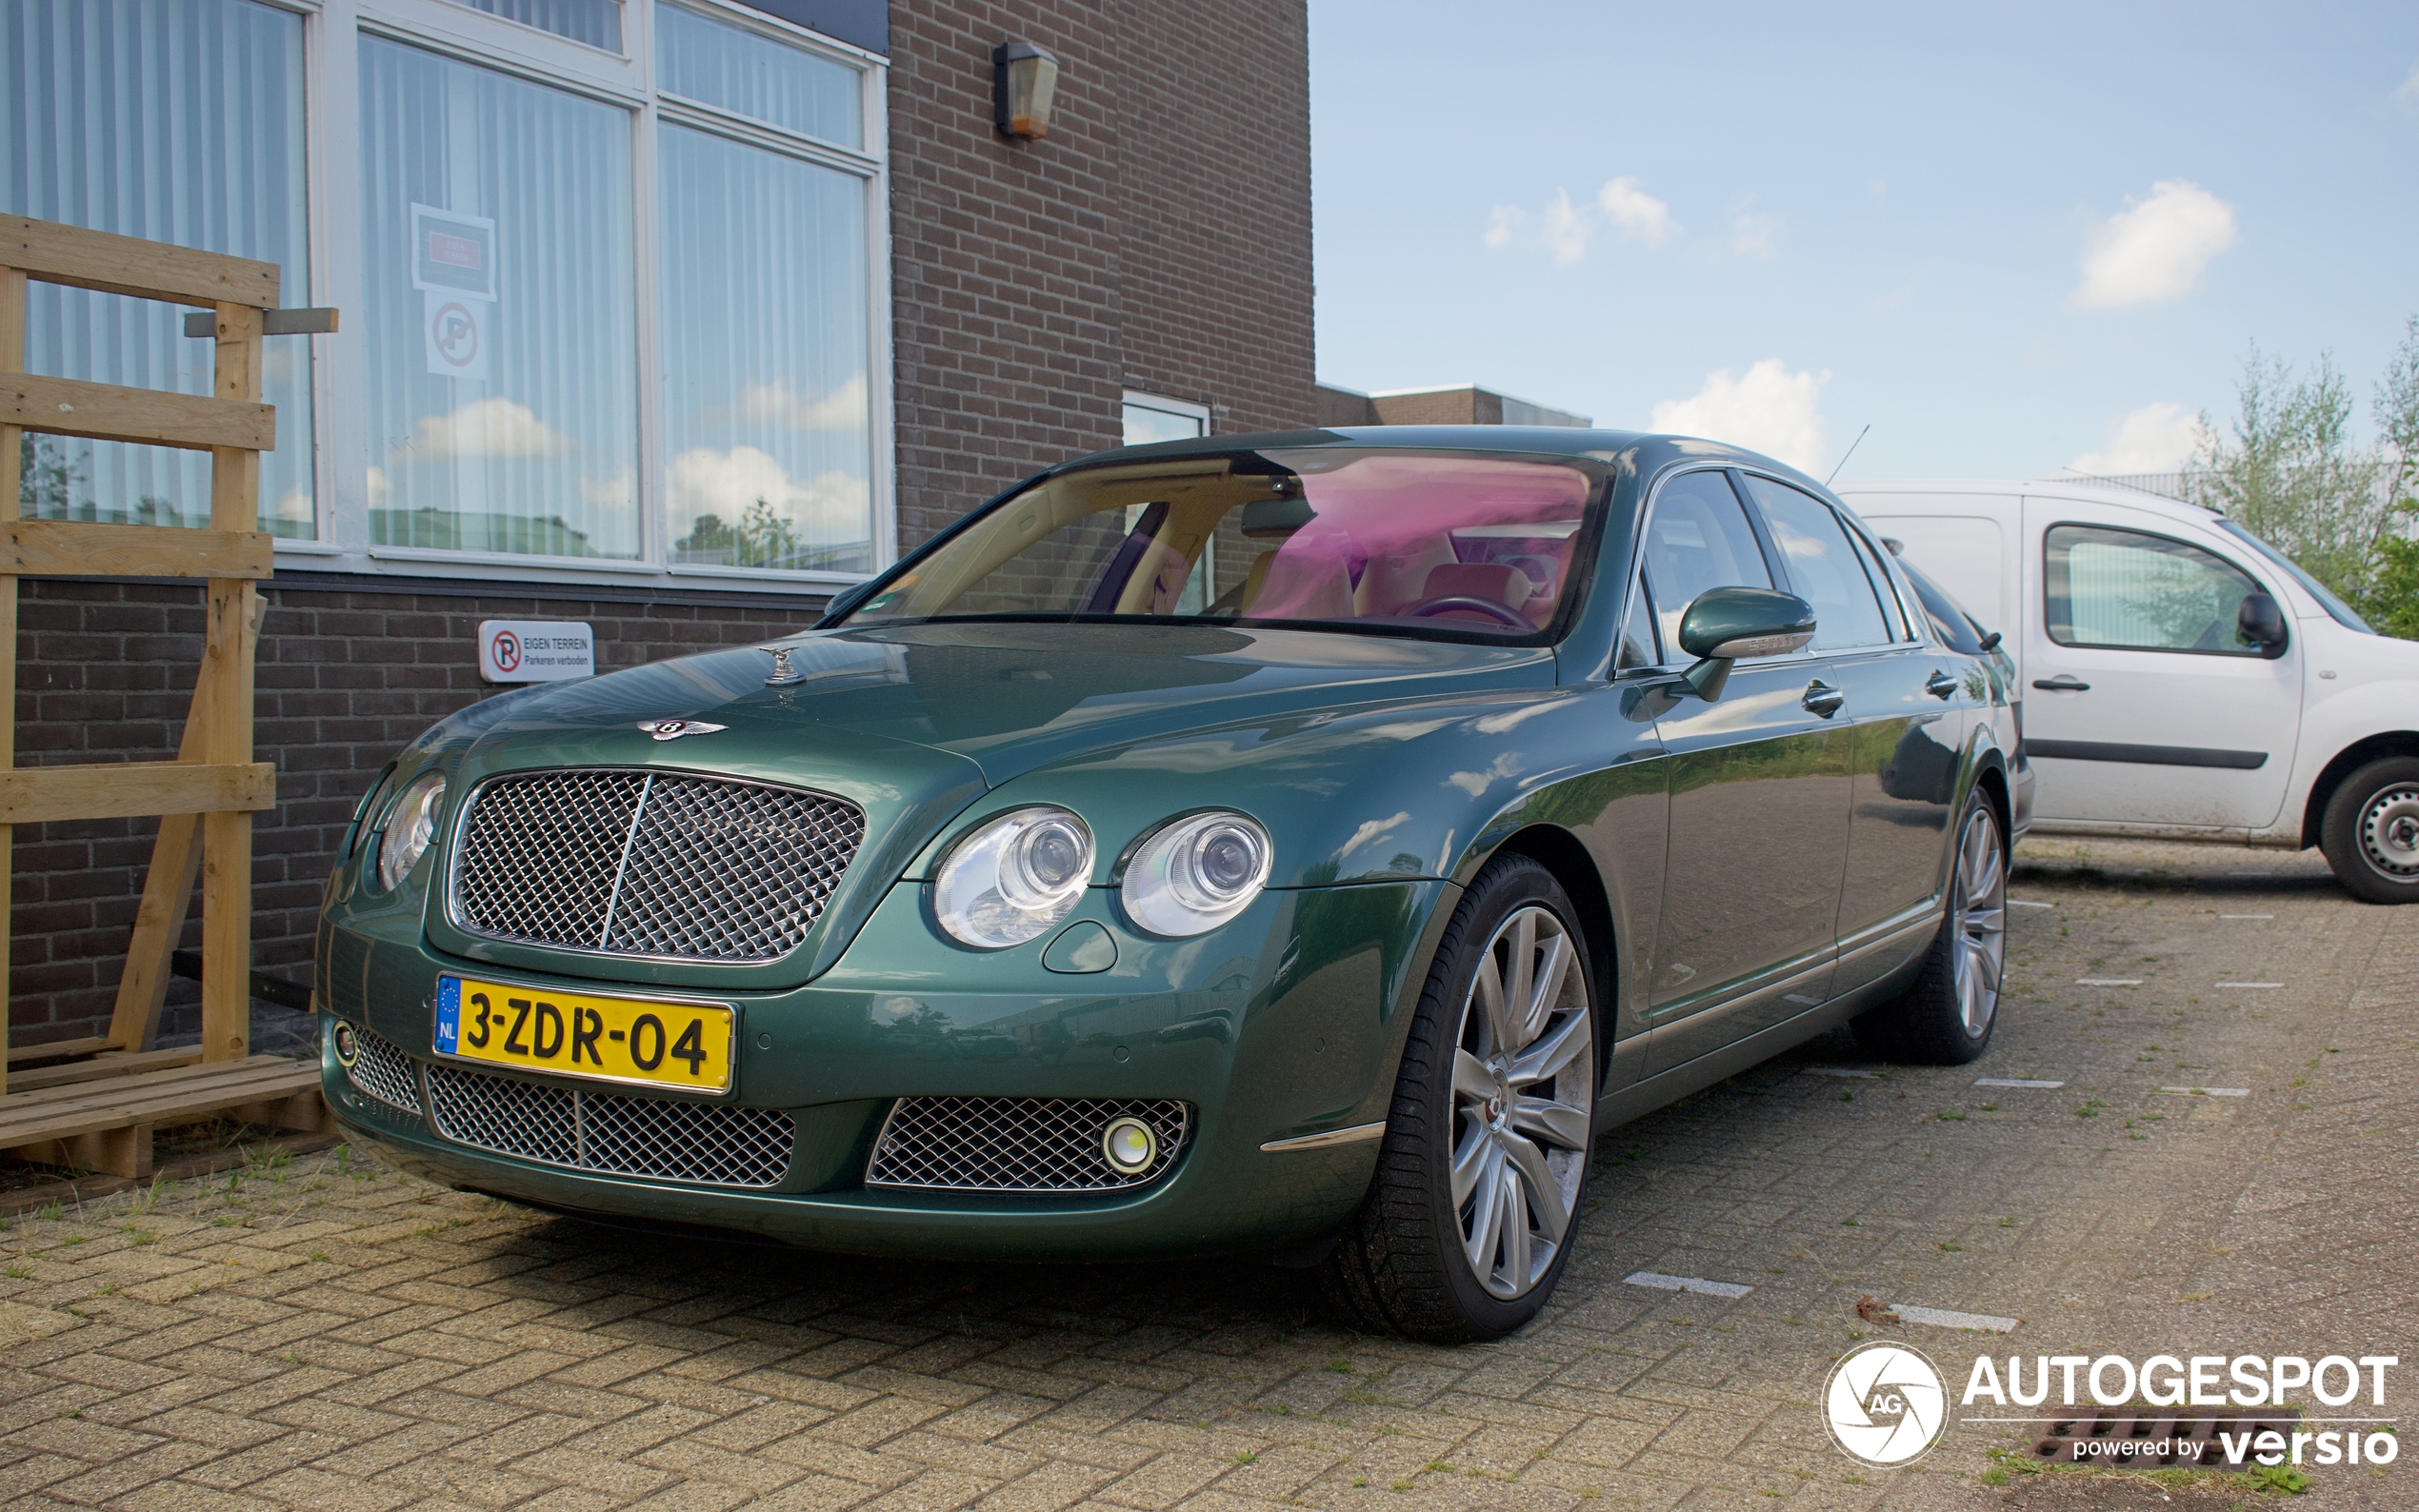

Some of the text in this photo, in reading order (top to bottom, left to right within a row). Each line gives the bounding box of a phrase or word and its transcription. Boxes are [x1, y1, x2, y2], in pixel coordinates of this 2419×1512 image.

[524, 637, 588, 649] EIGEN TERREIN
[524, 655, 589, 666] Parkeren verboden
[439, 1022, 455, 1041] NL
[467, 992, 707, 1076] 3-ZDR-04
